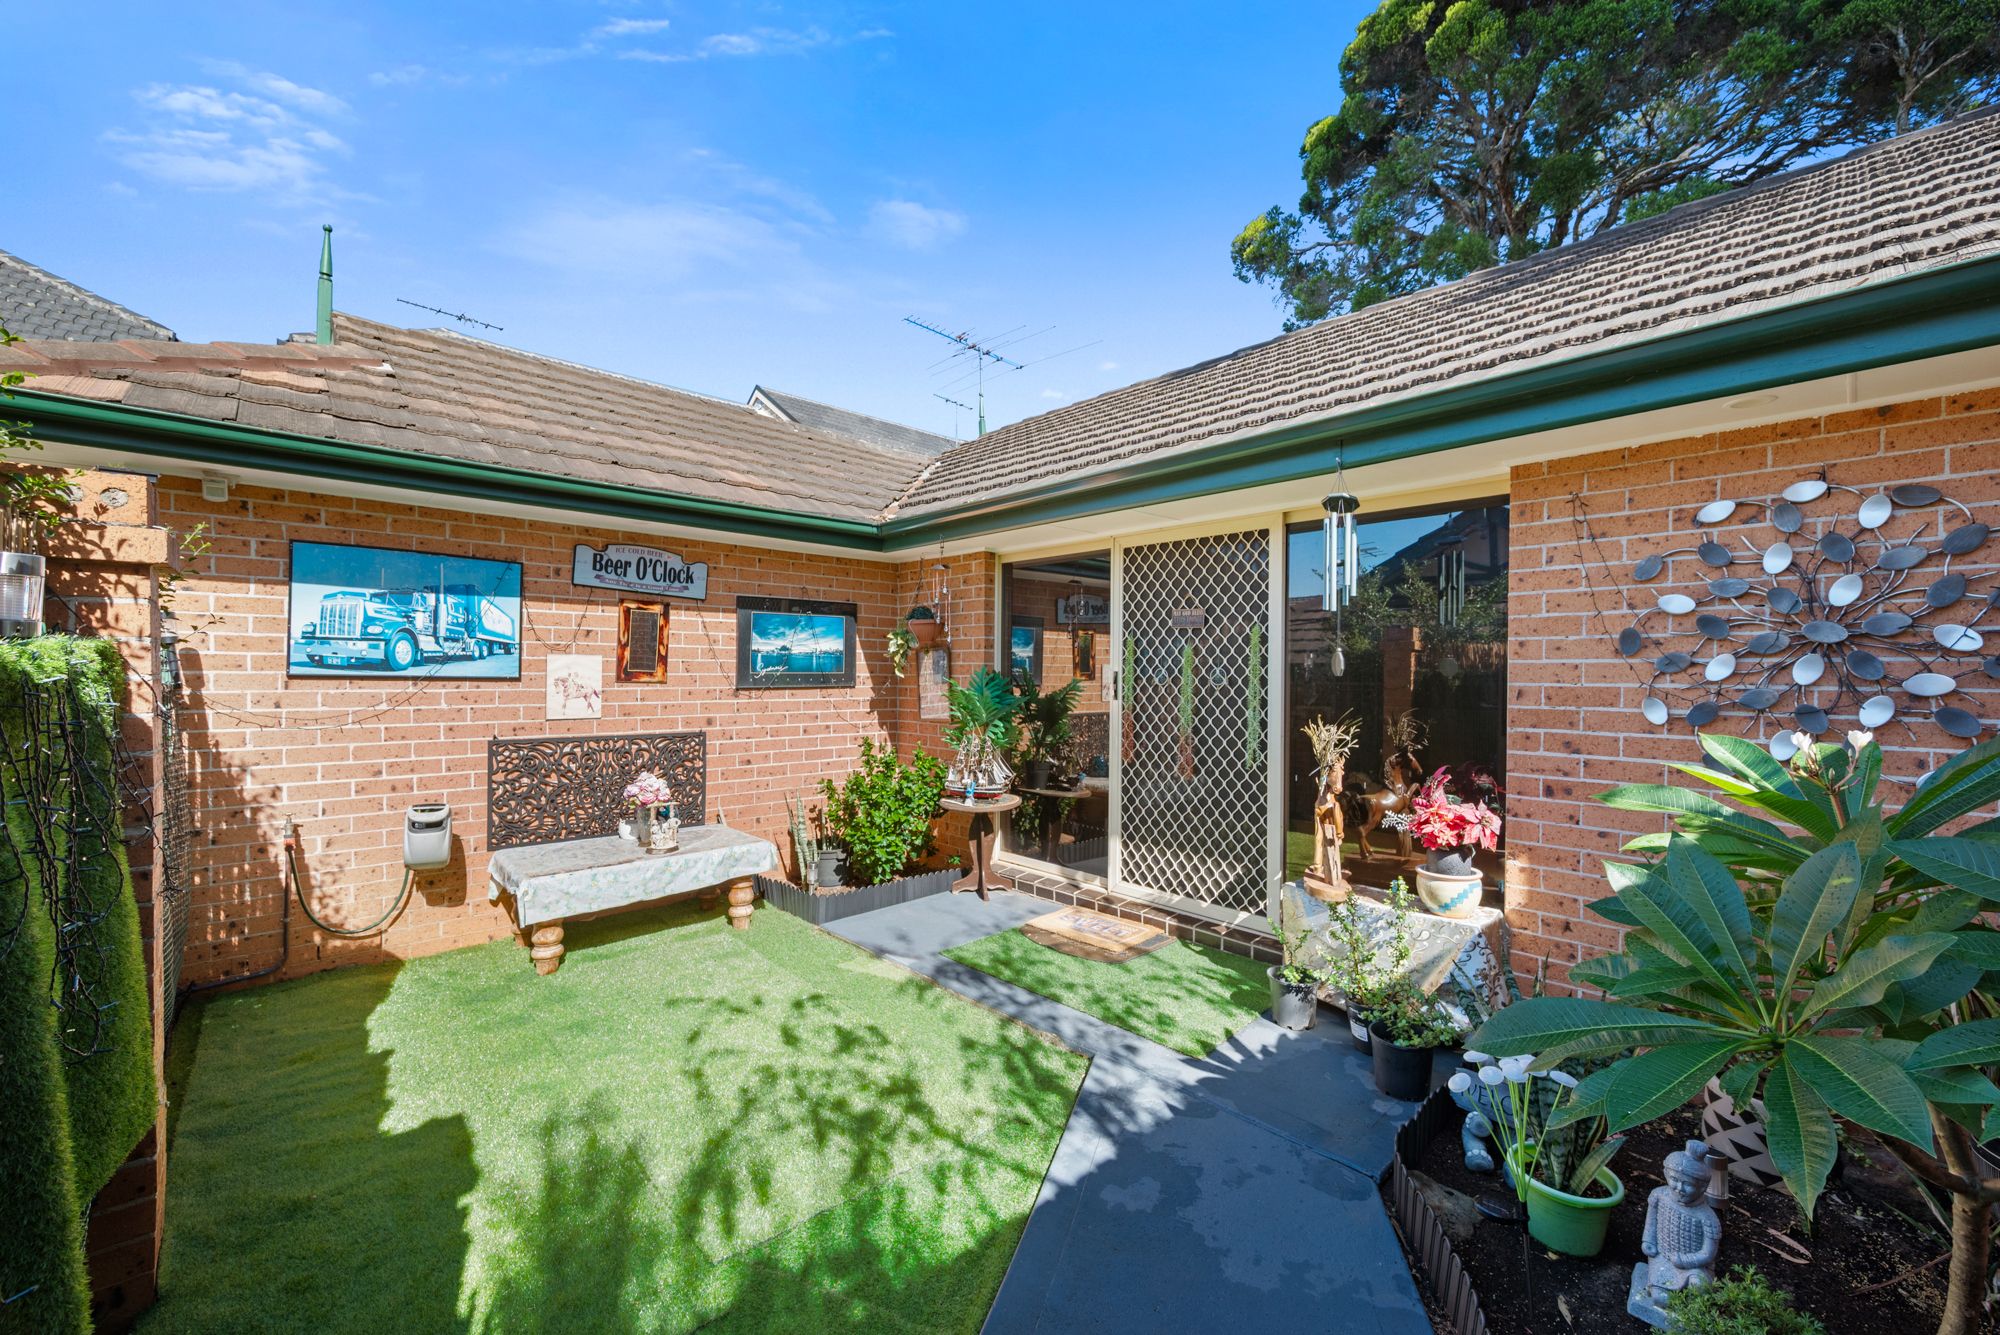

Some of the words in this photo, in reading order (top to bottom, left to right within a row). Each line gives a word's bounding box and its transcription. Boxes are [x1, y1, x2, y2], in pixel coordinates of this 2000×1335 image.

[592, 553, 632, 578] Beer
[636, 556, 695, 584] O'Clock
[754, 663, 788, 679] Sydney
